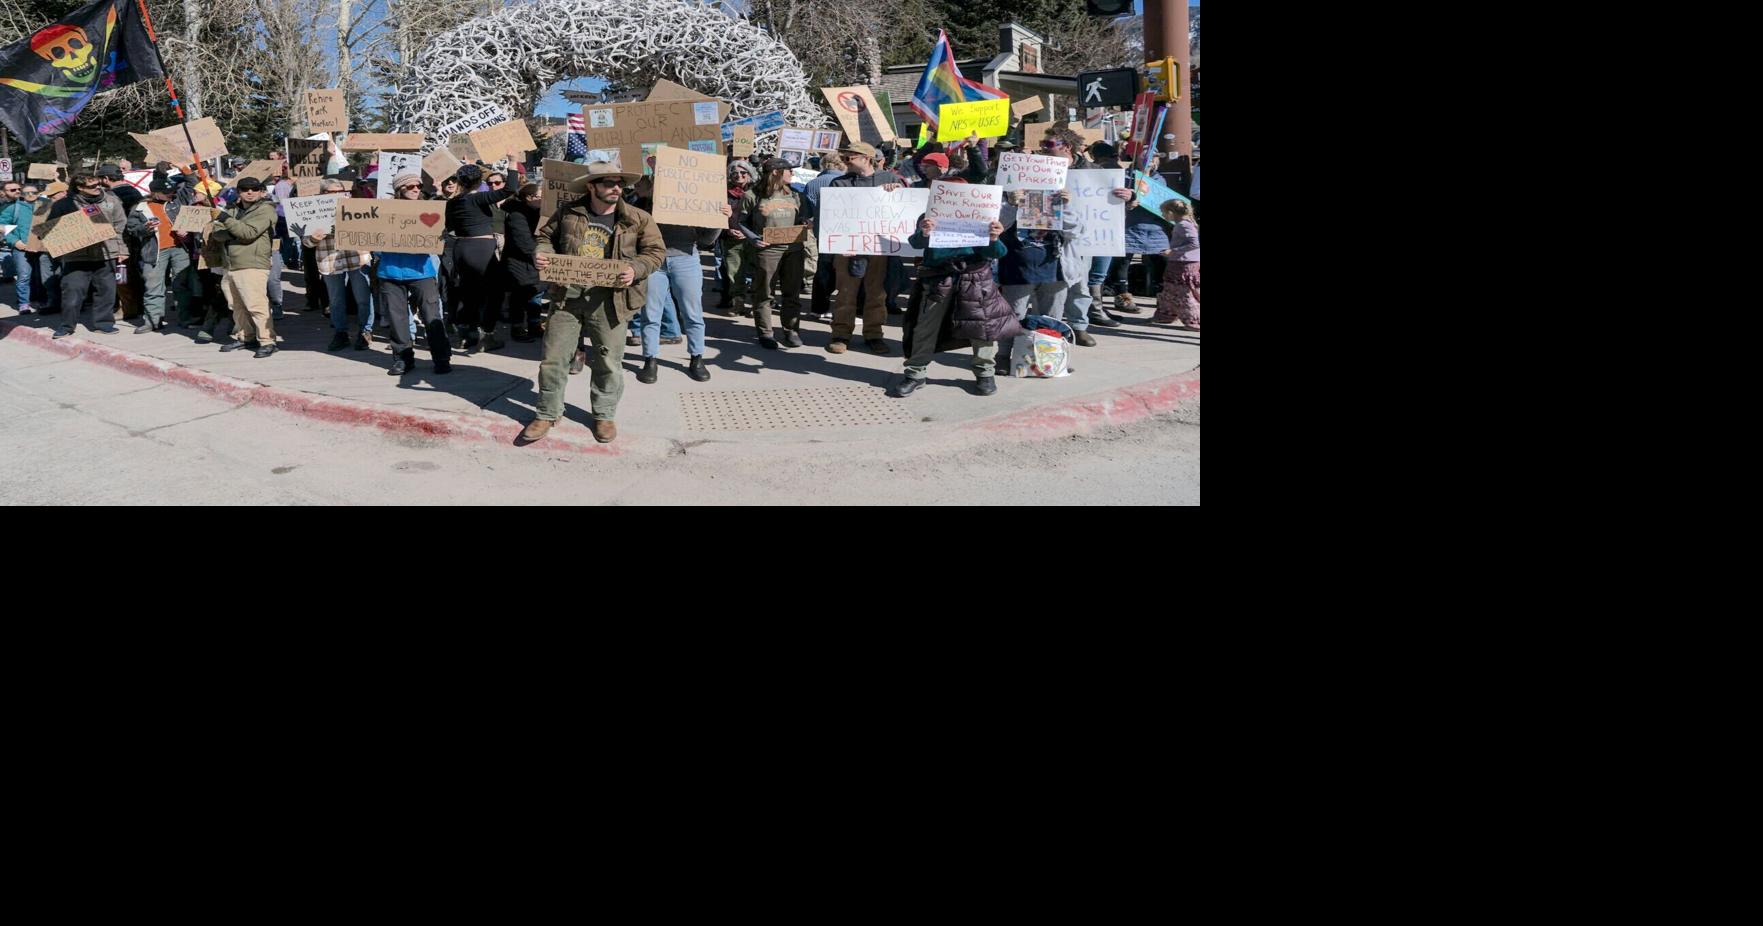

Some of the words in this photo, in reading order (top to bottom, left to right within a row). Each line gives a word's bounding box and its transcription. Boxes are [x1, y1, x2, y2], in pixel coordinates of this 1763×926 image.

[616, 102, 694, 119] PROTECT
[441, 115, 479, 139] HANDS
[478, 105, 496, 120] OFF
[636, 117, 668, 130] OUR
[593, 129, 642, 147] PUBLIC
[659, 126, 716, 142] LANDS
[679, 154, 698, 168] NO
[657, 166, 690, 181] PUBLIC
[548, 180, 568, 191] BUL
[677, 181, 698, 195] NO
[866, 205, 904, 219] CREW
[388, 213, 395, 225] if
[400, 217, 417, 230] you
[822, 222, 851, 233] WAS
[858, 220, 916, 235] ILLEGALL
[337, 230, 386, 247] PUBLIC
[828, 234, 901, 254] FIRED
[543, 267, 572, 276] WHAT
[574, 270, 592, 279] THE
